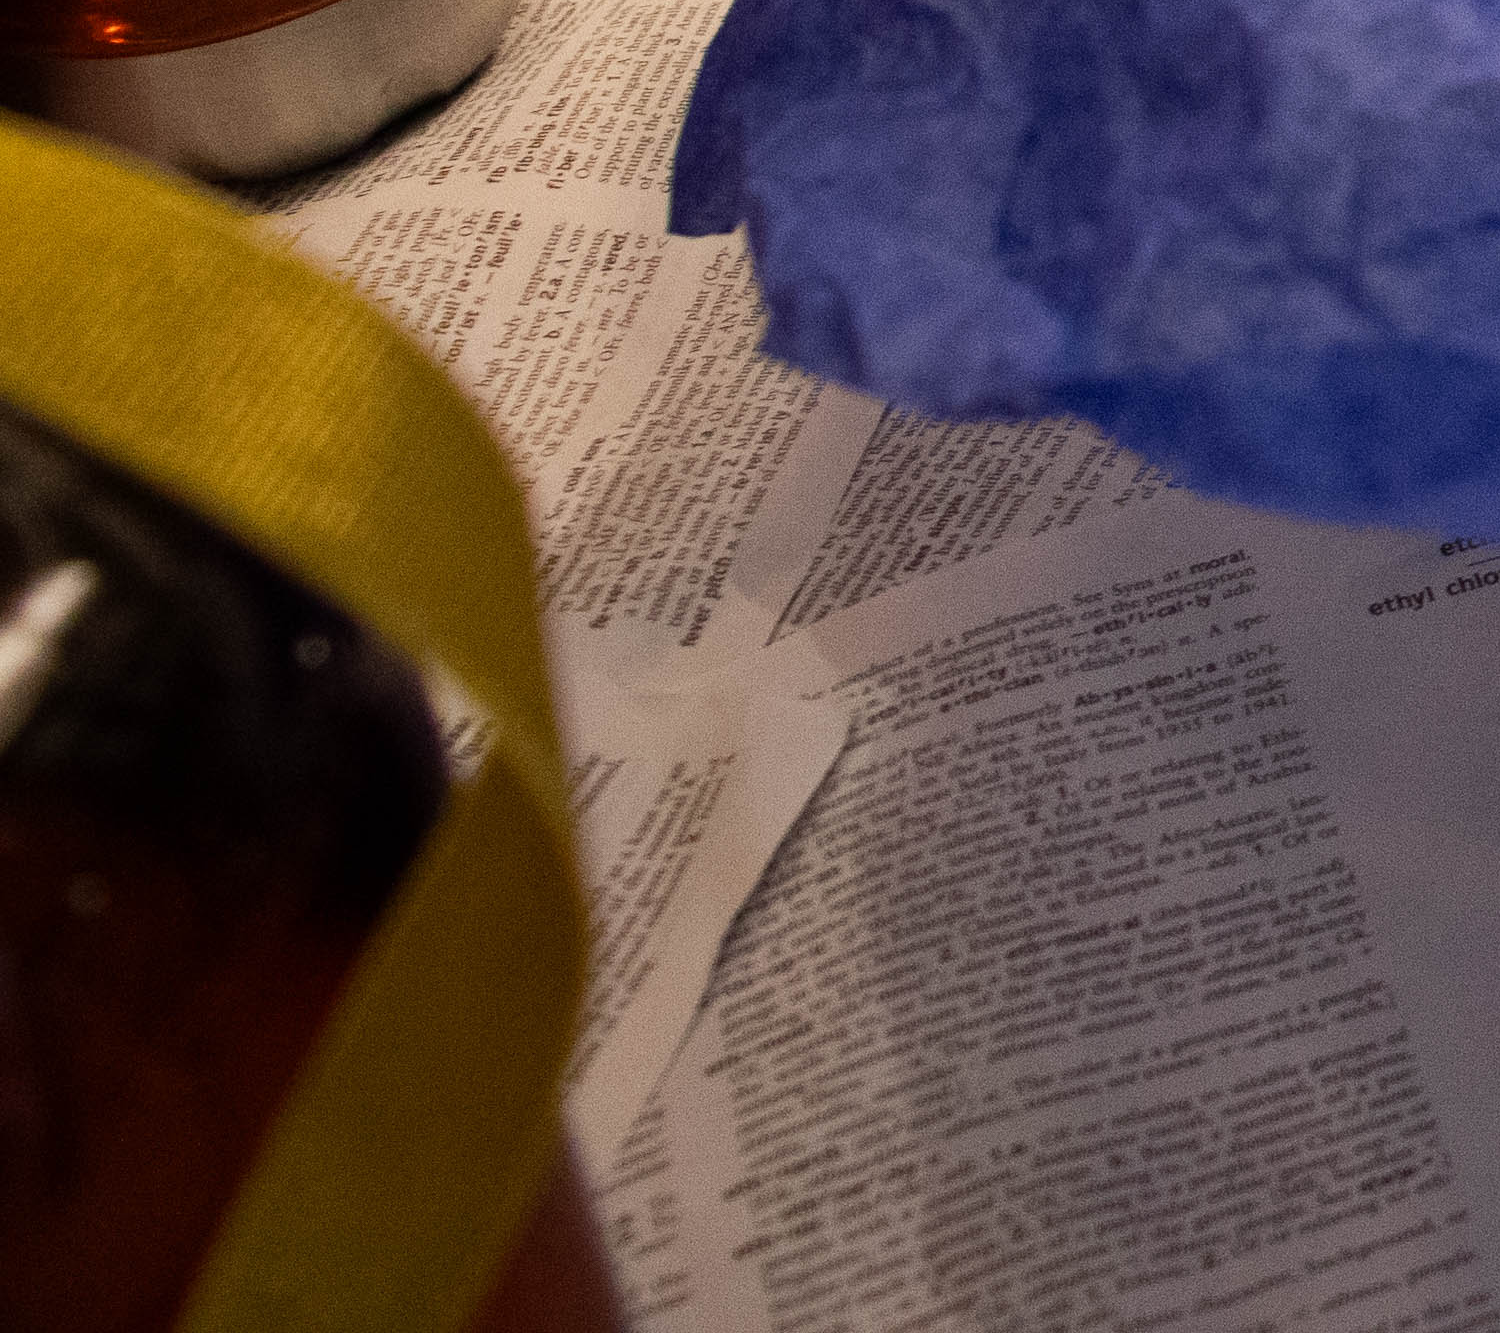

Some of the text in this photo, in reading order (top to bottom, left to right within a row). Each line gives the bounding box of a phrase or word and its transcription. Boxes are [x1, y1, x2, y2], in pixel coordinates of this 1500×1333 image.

[609, 58, 650, 113] elongated
[617, 133, 655, 187] stituting
[655, 39, 700, 110] extracellular
[693, 0, 721, 37] matrix
[597, 135, 631, 184] support
[630, 85, 656, 117] plant
[645, 126, 677, 173] various
[565, 227, 611, 304] contagious,
[634, 253, 663, 286] both
[683, 288, 712, 322] plant
[1368, 586, 1435, 616] ethyl
